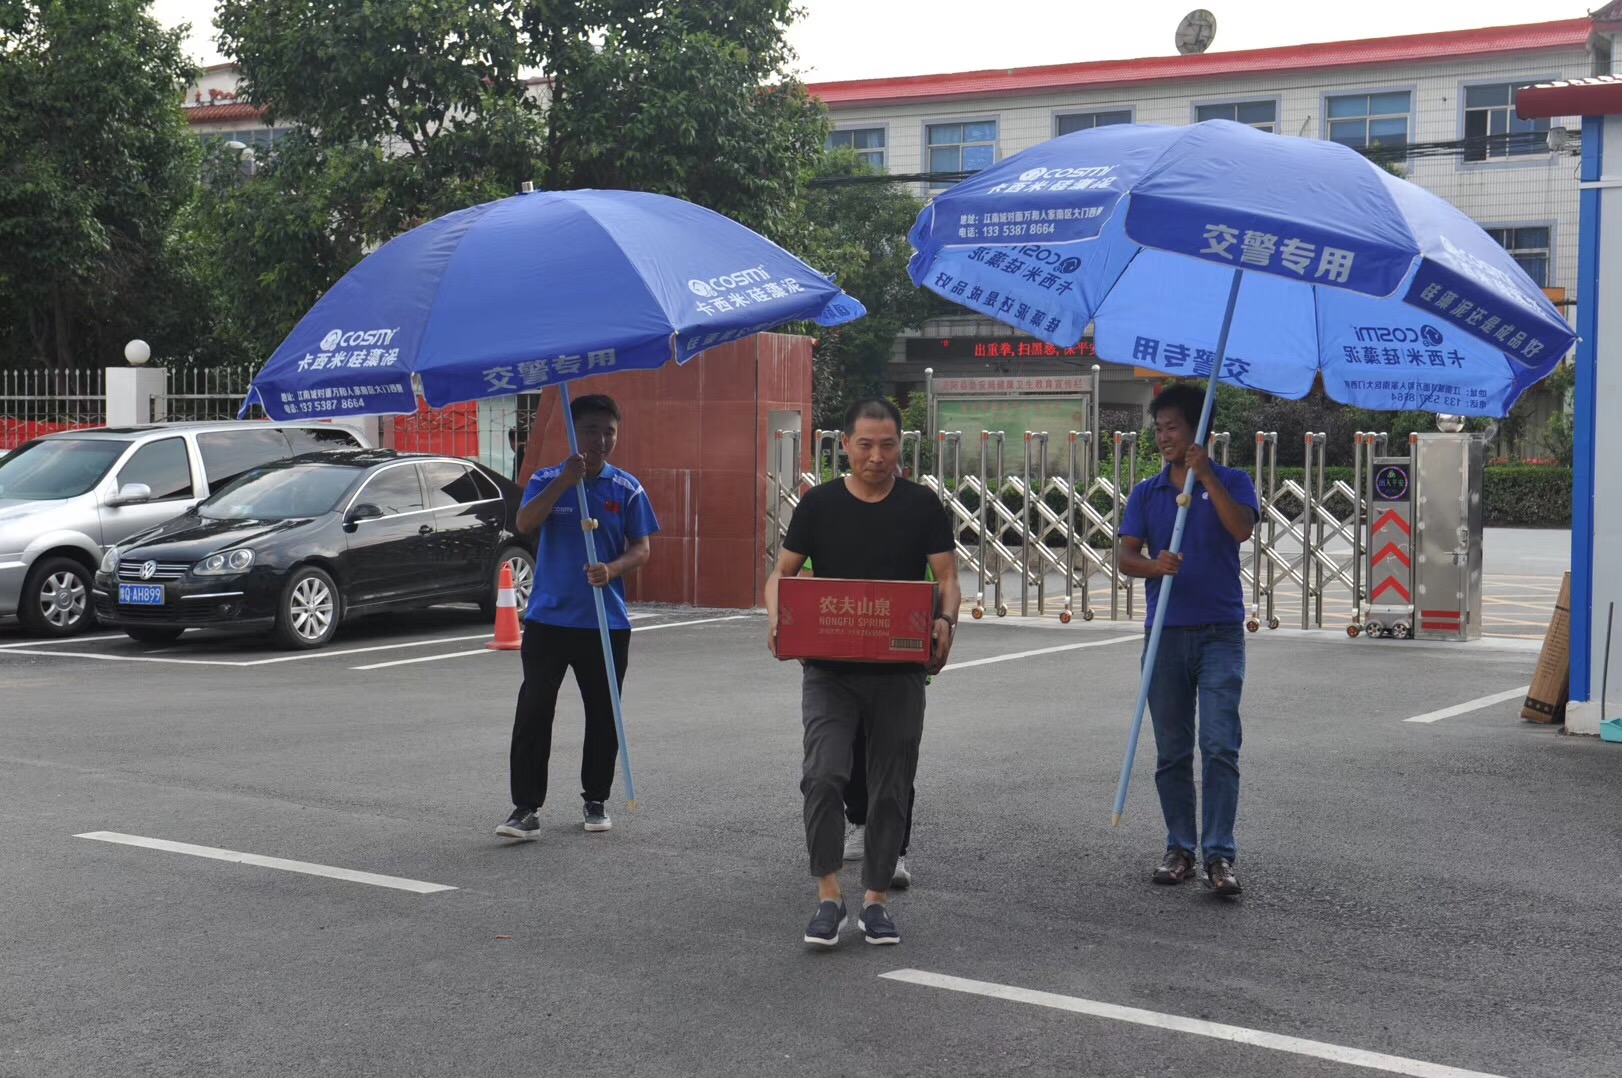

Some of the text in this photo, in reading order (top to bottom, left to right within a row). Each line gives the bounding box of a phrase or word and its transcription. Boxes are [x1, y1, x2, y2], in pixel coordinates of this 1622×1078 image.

[1002, 226, 1026, 236] 5387
[1030, 224, 1054, 234] 8664
[1201, 224, 1354, 283] 交警专用
[1420, 282, 1544, 358] 硅藻泥还是成品好
[482, 348, 616, 392] 交警专用
[315, 399, 337, 411] 5387
[342, 398, 365, 408] 8664
[819, 596, 890, 616] 农夫山泉
[820, 616, 890, 628] NONGFU SPRING
